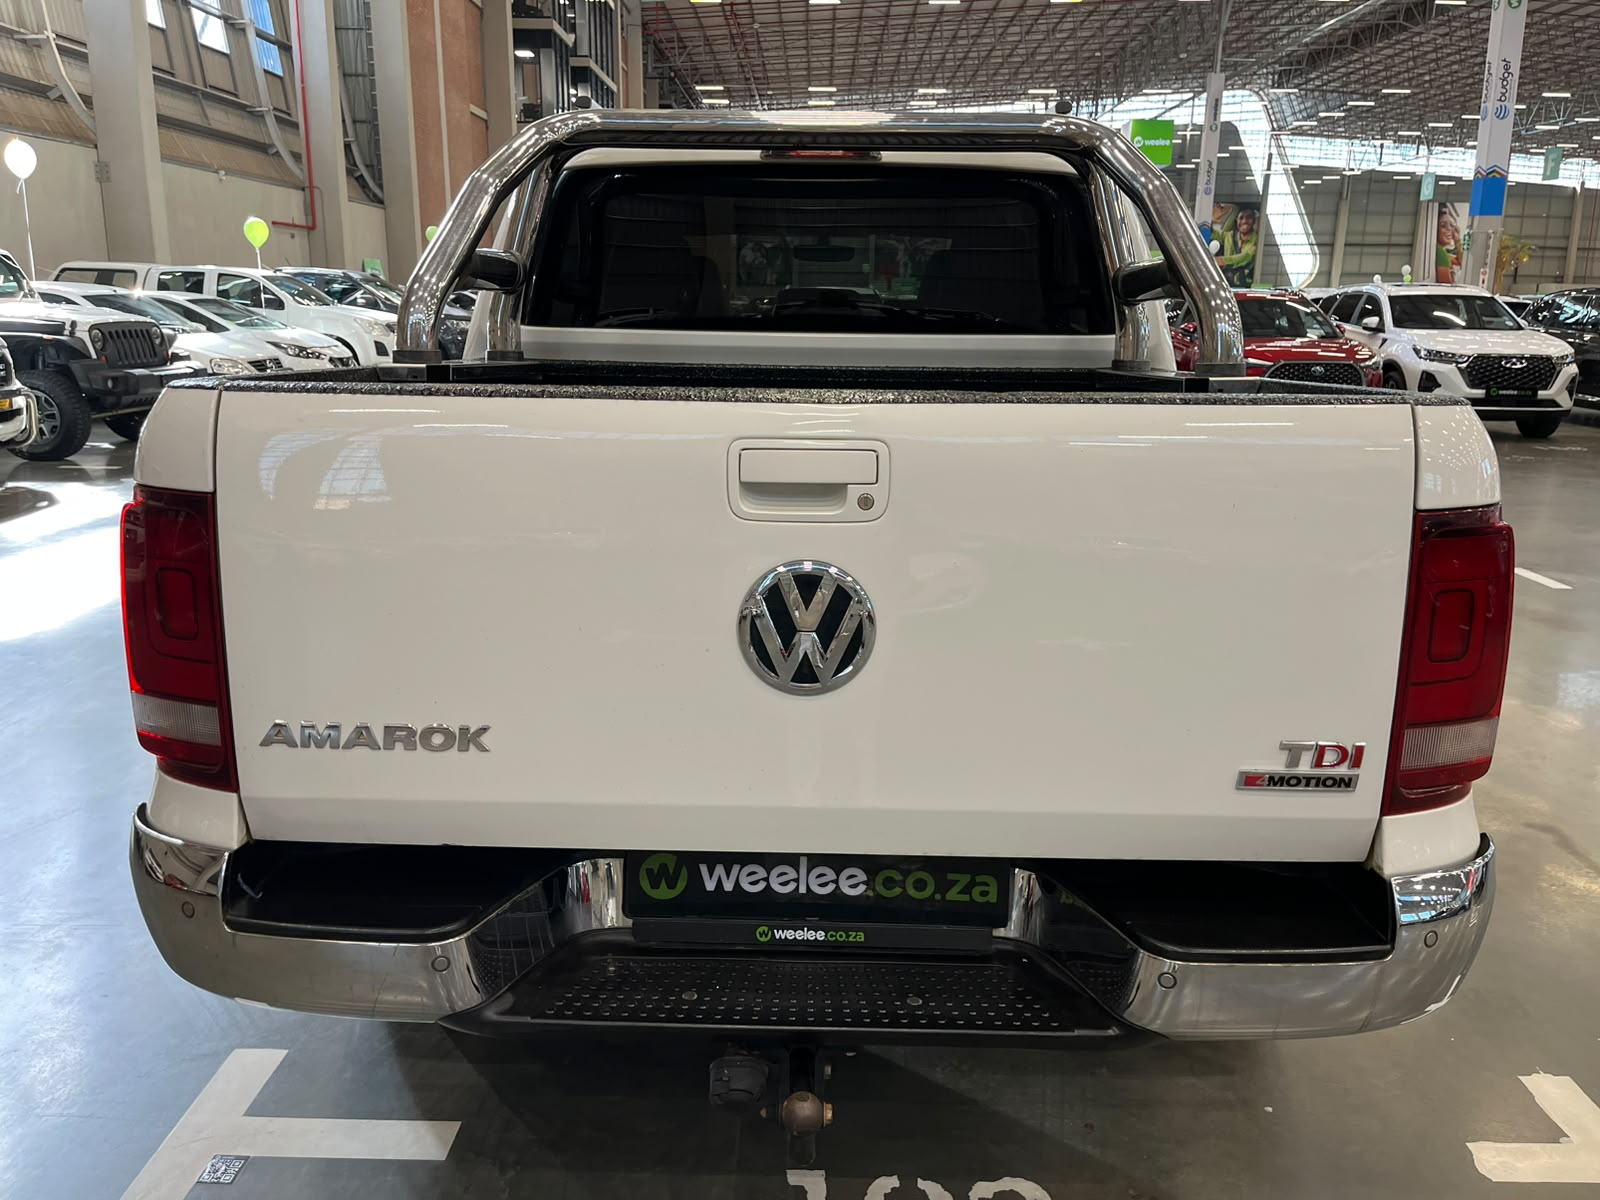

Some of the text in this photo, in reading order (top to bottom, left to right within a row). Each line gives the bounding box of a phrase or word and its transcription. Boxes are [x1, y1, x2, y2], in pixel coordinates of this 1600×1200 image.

[1497, 57, 1514, 102] budget
[1204, 160, 1213, 186] budget
[1546, 153, 1558, 176] F
[259, 719, 491, 753] AMAROK
[1279, 740, 1366, 769] TDI
[698, 855, 998, 904] weelee.co.za
[774, 927, 865, 942] weelee.co.za
